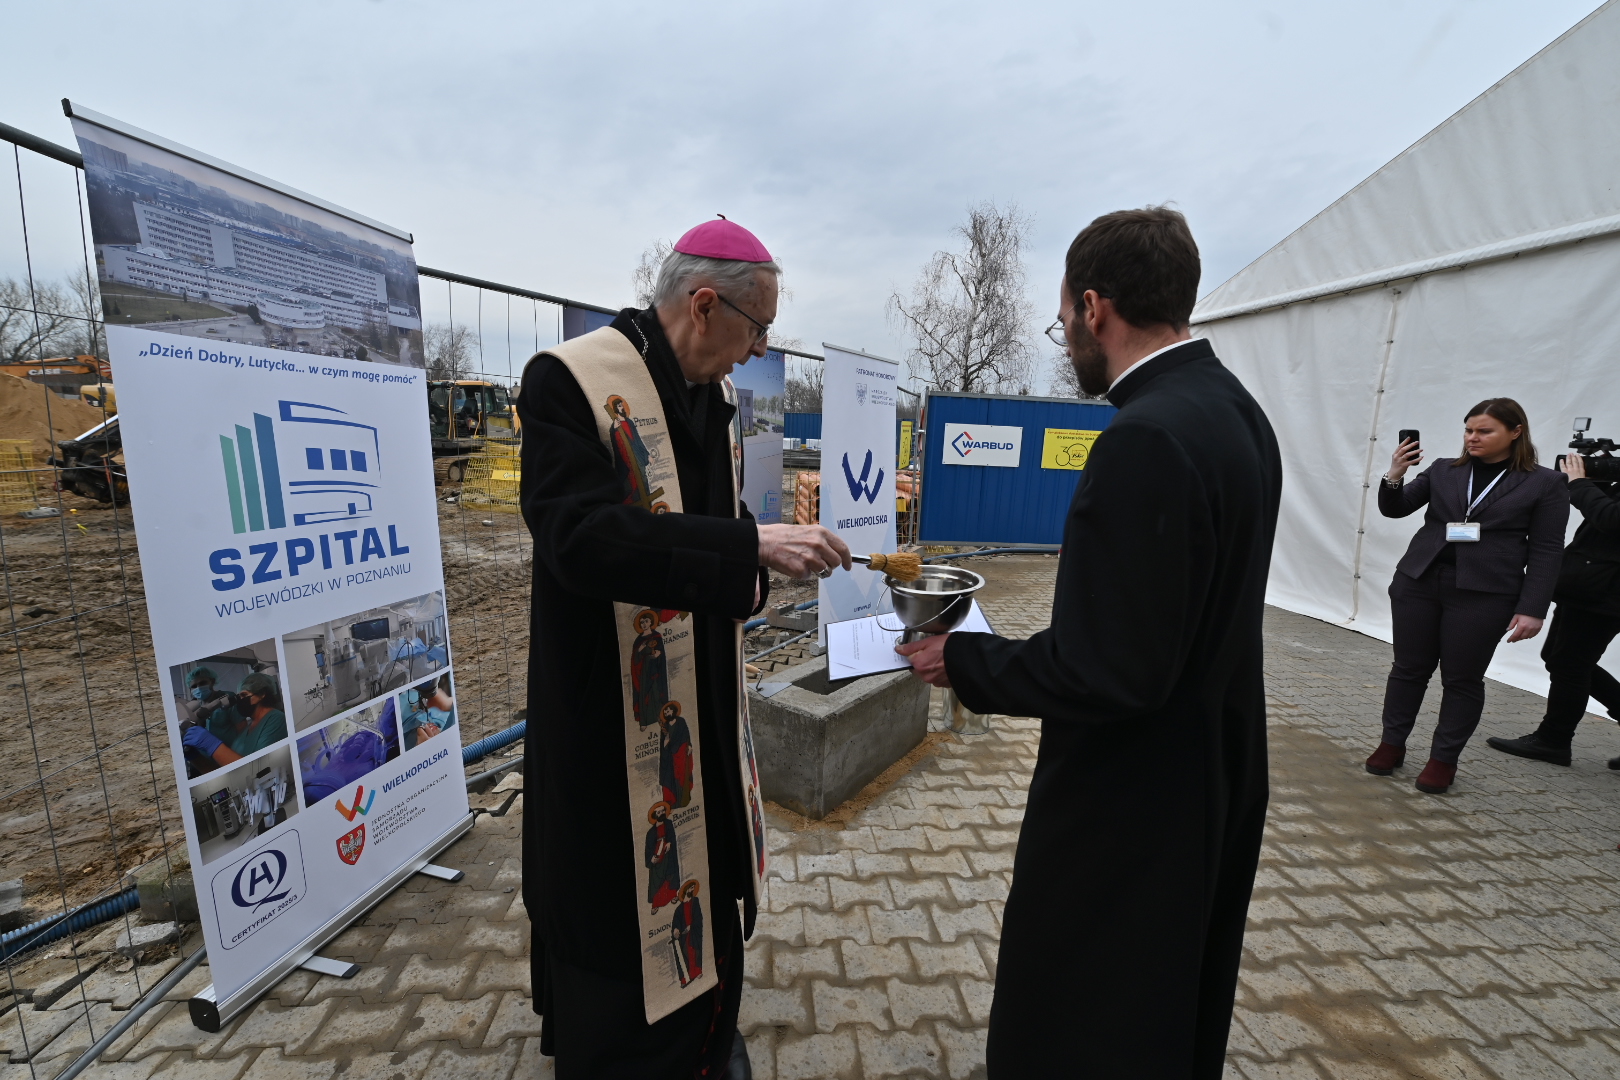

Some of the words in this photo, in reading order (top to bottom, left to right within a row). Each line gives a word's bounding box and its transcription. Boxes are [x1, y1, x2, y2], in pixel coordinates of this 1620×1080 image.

[28, 368, 61, 376] CASE
[139, 342, 193, 360] „Dzień
[198, 349, 245, 368] Dobry,
[248, 355, 305, 373] Lutycka...
[308, 365, 319, 375] w
[321, 367, 349, 379] czym
[352, 370, 380, 383] mogę
[962, 440, 1014, 451] WARBUD
[837, 514, 888, 530] WIELKOPOLSKA
[208, 524, 410, 592] SZPITAL
[215, 581, 324, 618] WOJEWÓDZKI
[328, 577, 342, 591] W
[346, 562, 412, 588] POZNANIU
[634, 739, 659, 752] COBUS
[634, 746, 660, 760] MINOR
[382, 748, 449, 793] WIELKOPOLSKA
[371, 801, 405, 827] JEDNOSTKA
[405, 773, 448, 803] ORGANIZACYJNA
[672, 805, 700, 822] BARTHO
[372, 806, 418, 839] WOJEWÓDZTWA
[373, 807, 426, 846] WIELKOPOLSKIEGO
[231, 908, 276, 943] CERTYFIKAT
[277, 894, 298, 912] 2025/3
[648, 921, 672, 939] SIMON
